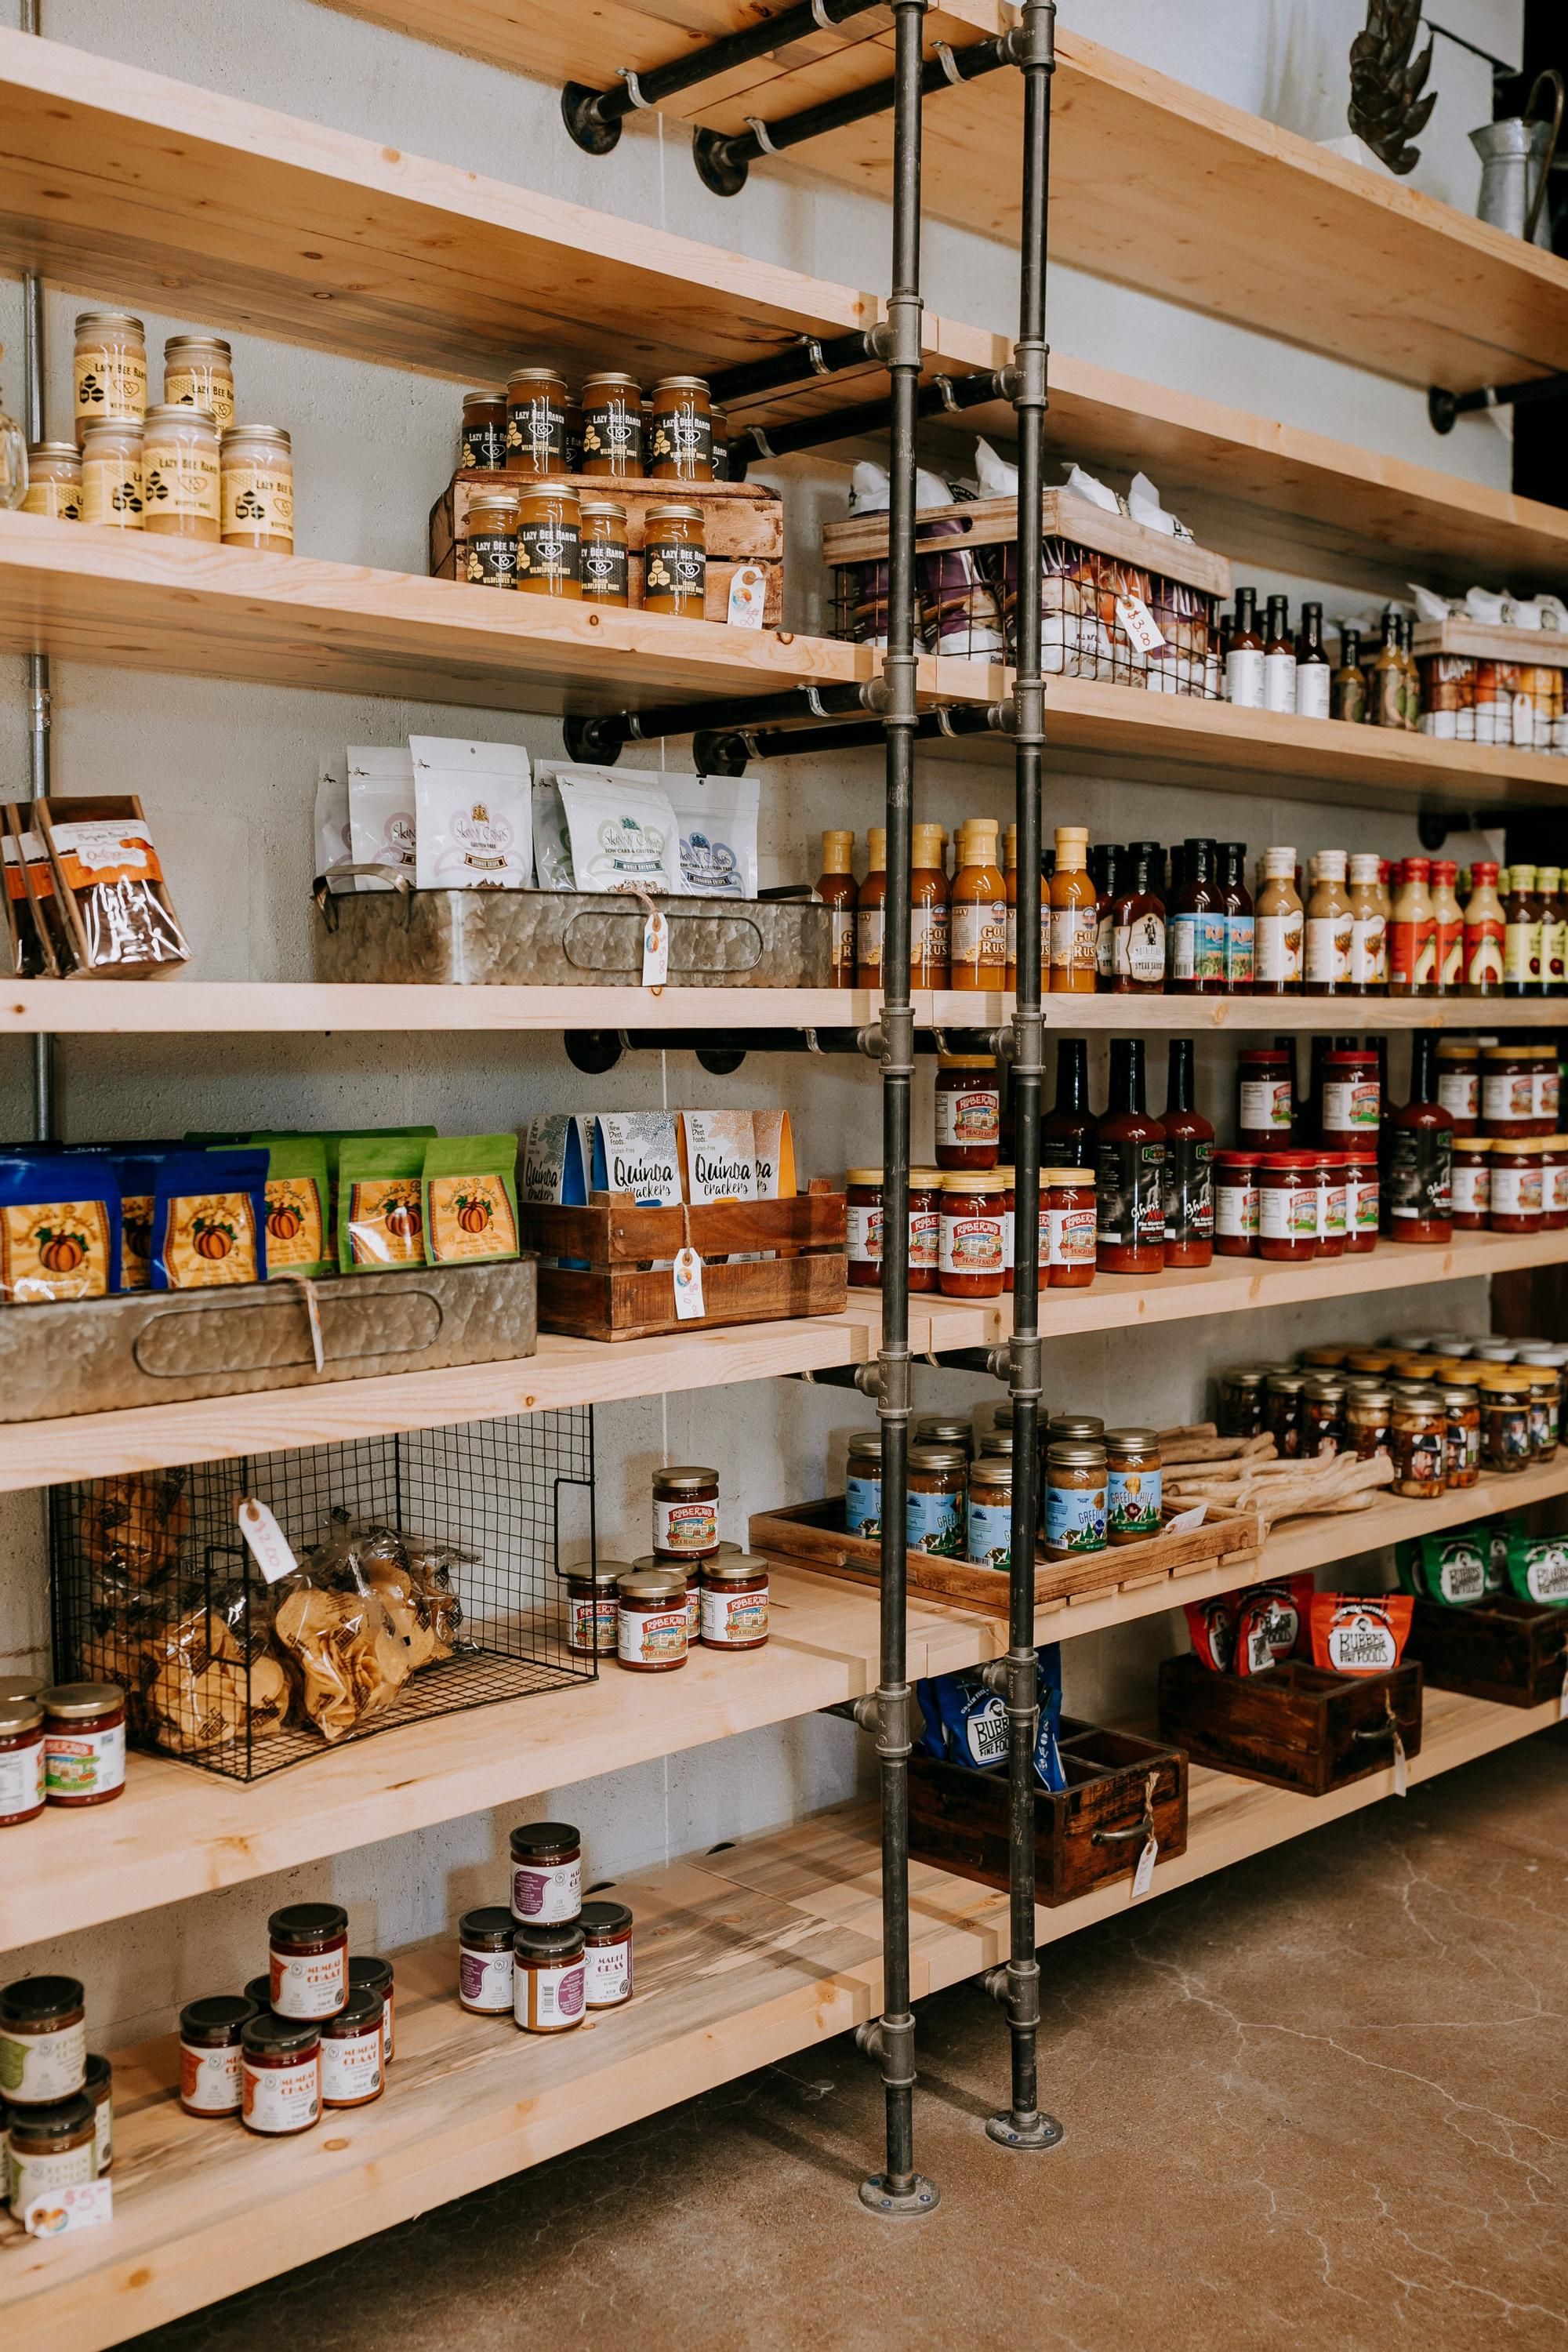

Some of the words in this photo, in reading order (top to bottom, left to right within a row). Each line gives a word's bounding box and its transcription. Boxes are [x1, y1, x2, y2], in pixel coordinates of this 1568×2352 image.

[213, 386, 225, 397] BEE
[515, 411, 530, 421] LAZY
[593, 415, 608, 424] LAZY
[469, 433, 482, 442] LAZY
[523, 531, 538, 541] LAZY
[539, 529, 554, 541] BEE
[556, 529, 578, 543] RANCH
[476, 541, 491, 552] LAZY
[493, 540, 508, 551] BEE
[590, 546, 604, 557] BEE
[606, 547, 625, 560] RANCH
[662, 549, 679, 560] LAZY
[680, 549, 694, 560] BEE
[922, 943, 948, 956] RUS
[982, 940, 1005, 954] RUS
[1073, 945, 1095, 957] RUS
[526, 1156, 558, 1189] Quinoa
[614, 1156, 674, 1187] Quinoa
[695, 1153, 753, 1184] Quinoa
[704, 1178, 750, 1196] crackers
[1131, 1200, 1160, 1221] Ghost
[1185, 1196, 1212, 1219] Ghost
[956, 1221, 999, 1236] ROBERTO'S
[1110, 1492, 1133, 1504] GREEN
[1136, 1492, 1155, 1504] CHILE
[672, 1507, 713, 1520] ROBERTO'S
[1078, 1508, 1102, 1524] GREEN
[1356, 1649, 1388, 1664] FOODS
[979, 1746, 995, 1757] FINE
[598, 1953, 624, 1965] MARDI
[597, 1962, 624, 1973] GRAS
